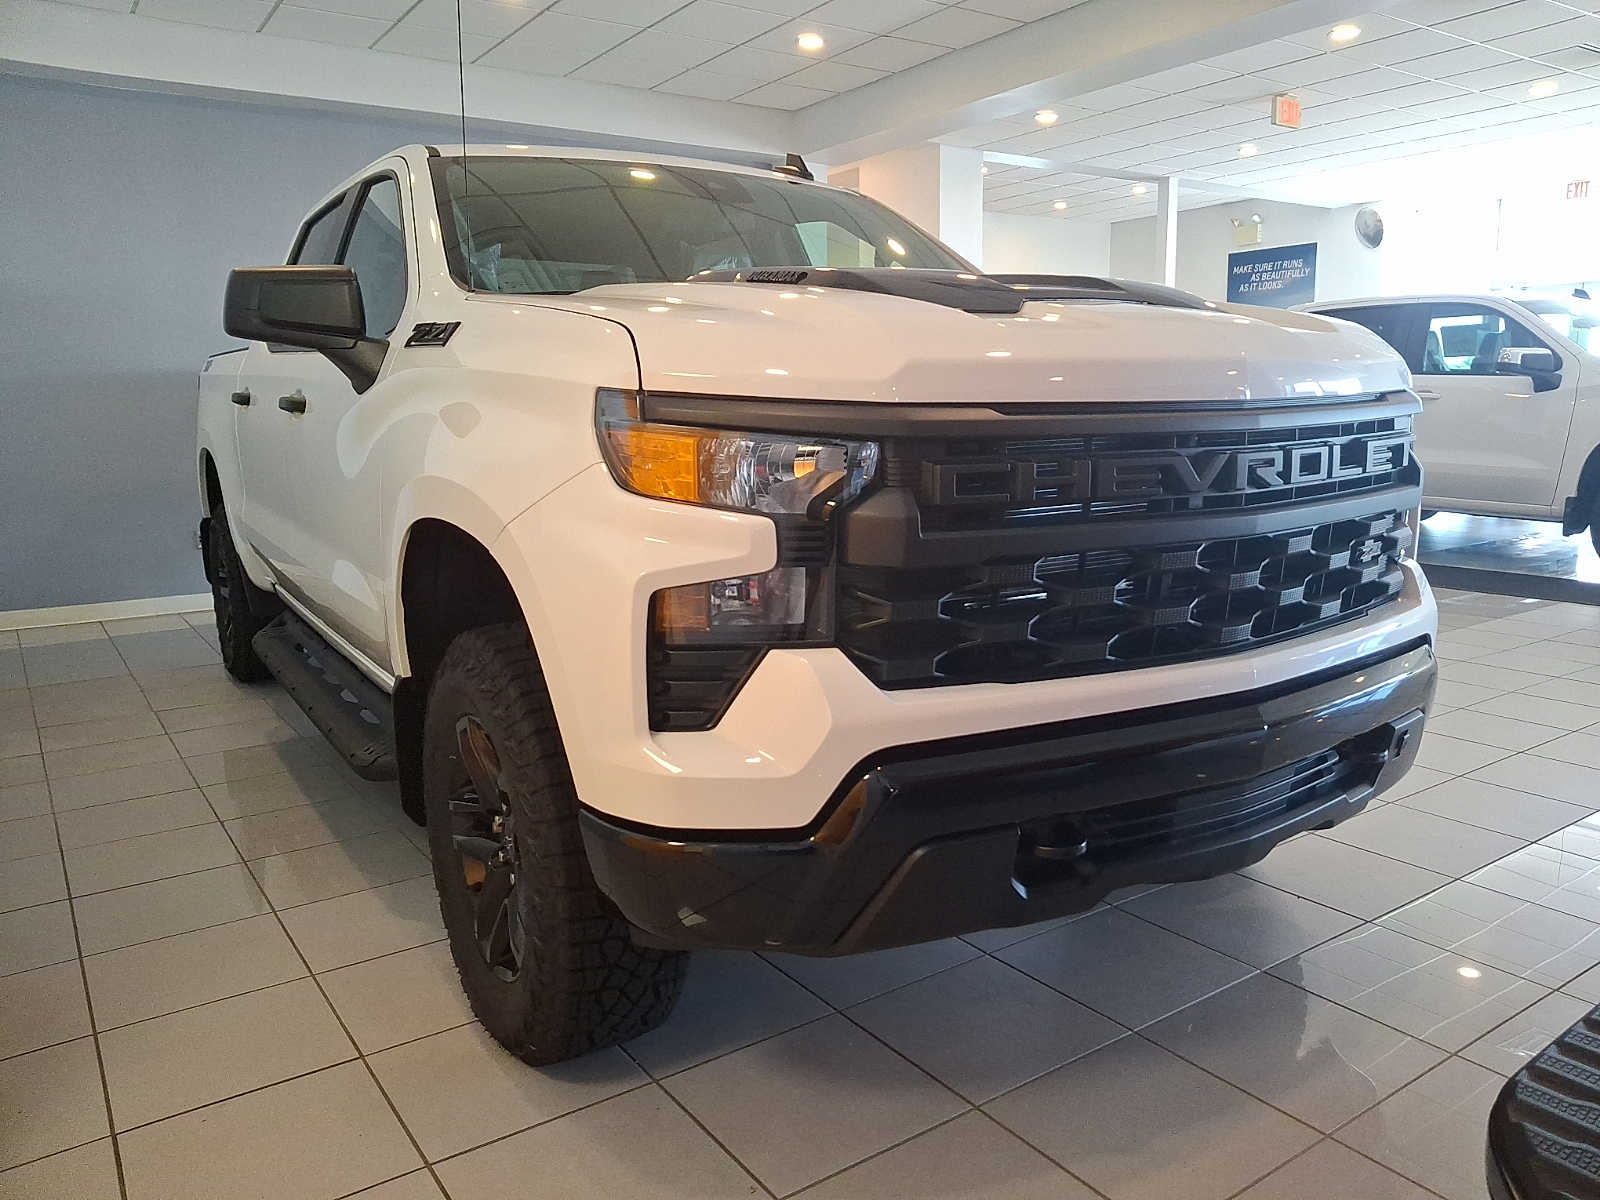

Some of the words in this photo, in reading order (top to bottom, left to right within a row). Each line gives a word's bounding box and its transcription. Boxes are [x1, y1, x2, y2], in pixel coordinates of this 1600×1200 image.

[1566, 180, 1591, 200] EXIT
[1233, 264, 1253, 274] MAKE
[1254, 262, 1273, 272] SURE
[1274, 260, 1282, 270] IT
[1282, 259, 1303, 269] RUNS
[1251, 272, 1260, 281] AS
[1261, 268, 1310, 280] BEAUTIFULLY
[1239, 283, 1248, 292] AS
[1250, 282, 1257, 291] IT
[921, 437, 1411, 507] CHEVROLET
